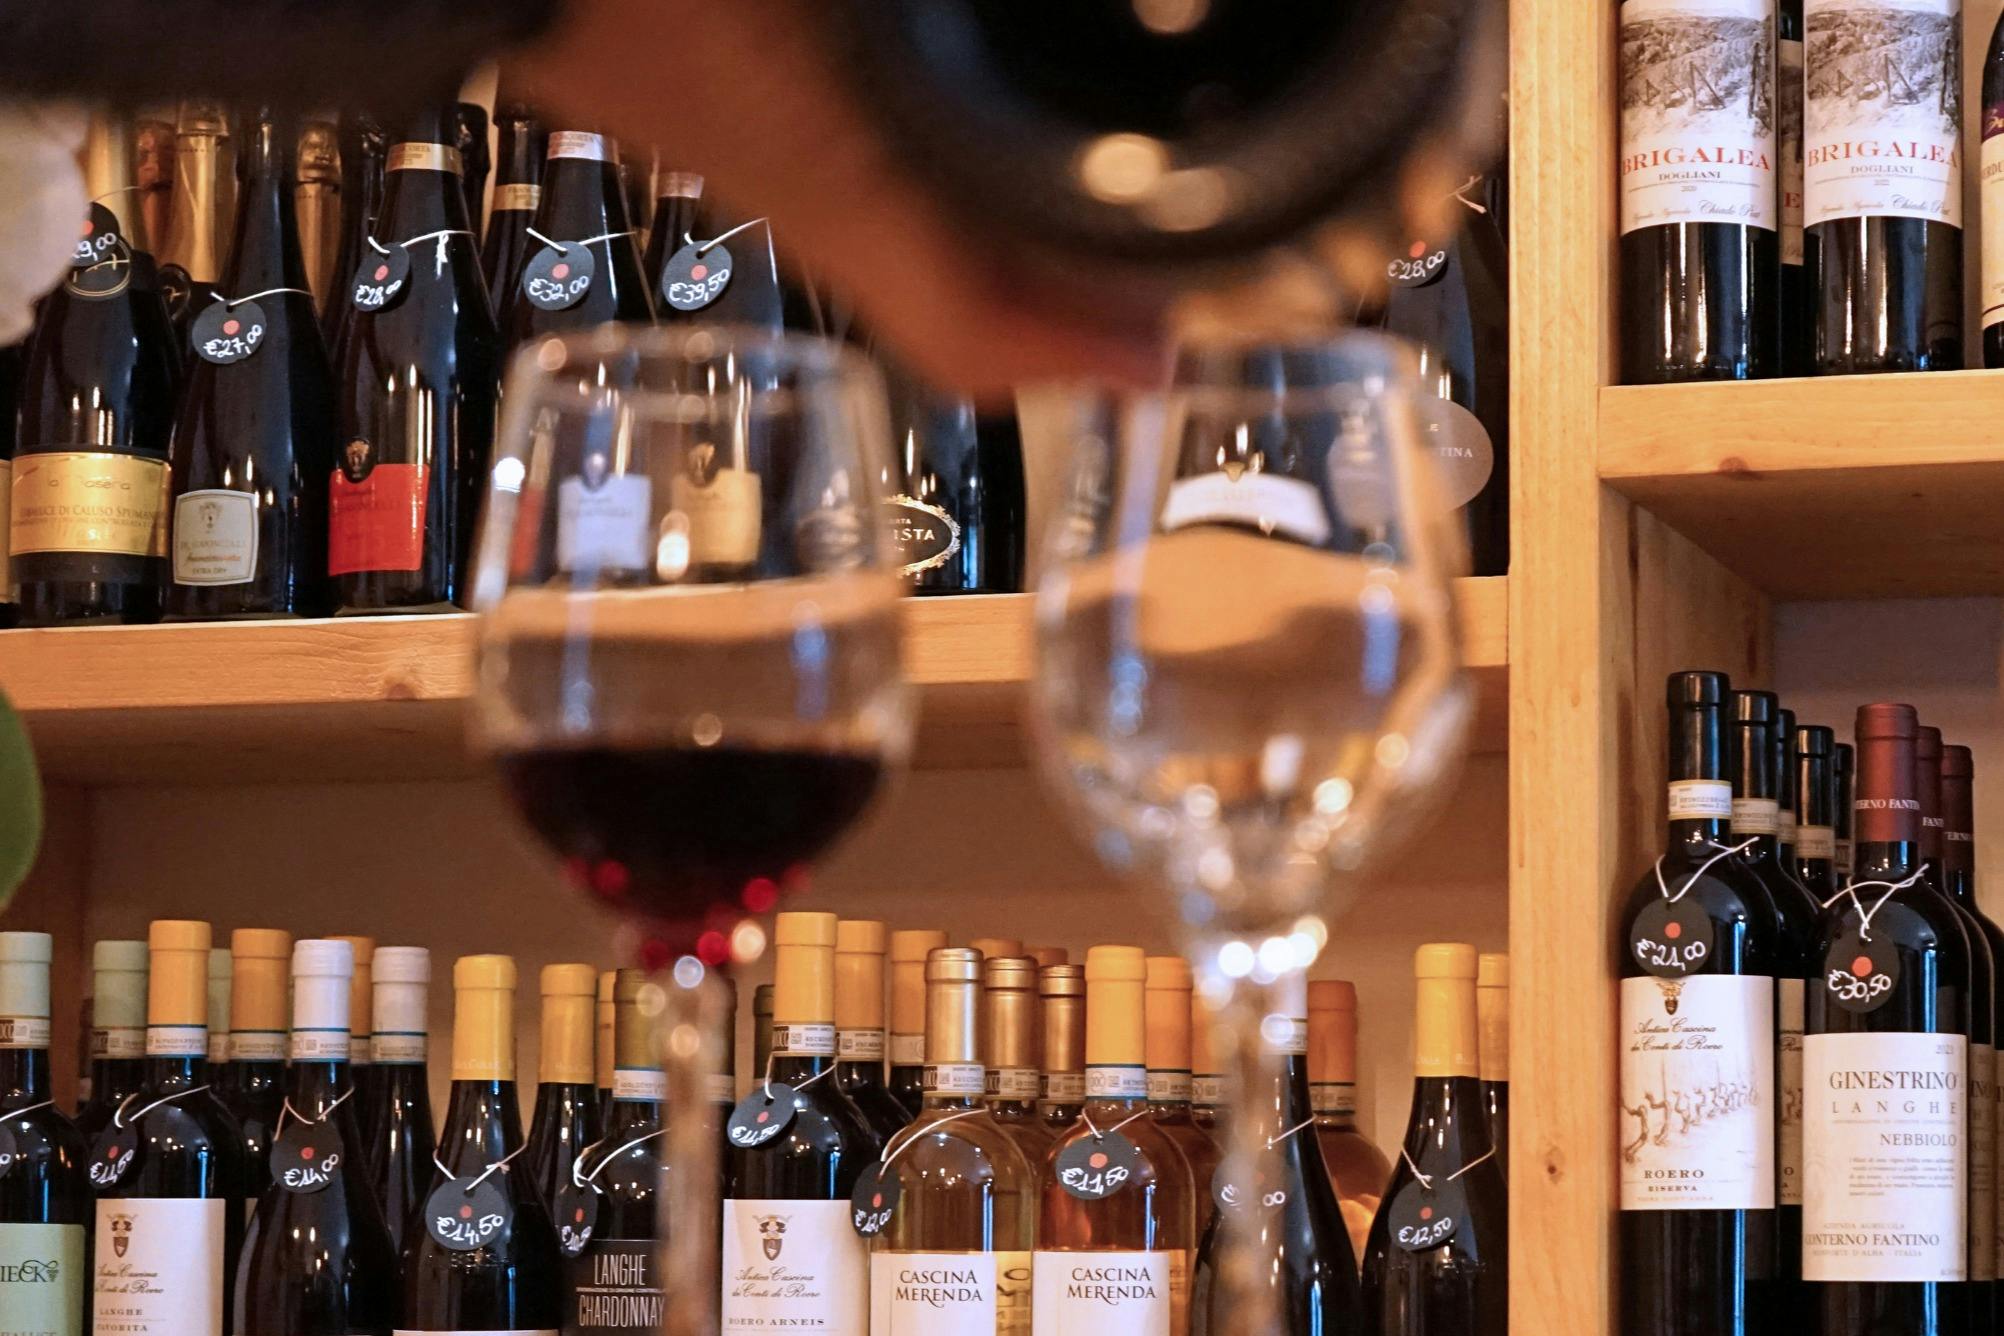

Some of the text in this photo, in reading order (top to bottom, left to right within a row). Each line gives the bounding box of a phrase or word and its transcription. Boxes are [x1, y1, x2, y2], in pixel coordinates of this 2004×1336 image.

[1623, 147, 1770, 175] BRIGALEA
[1807, 141, 1958, 168] BRIGALEA
[1659, 171, 1721, 181] DOGLIANI
[1850, 165, 1914, 174] DOGLIANI
[1387, 250, 1445, 279] €28,00
[355, 279, 402, 306] €28,00
[529, 275, 590, 302] €32,00
[668, 269, 730, 303] €39,50
[203, 324, 263, 358] €27,00
[1636, 938, 1706, 971] €21,00
[1828, 970, 1892, 1003] €30,50
[1829, 1071, 1957, 1090] GINESTRINO
[1832, 1101, 1957, 1114] LANGHE
[1880, 1133, 1957, 1146] NEBBIOLO
[284, 1154, 339, 1187] €14,00
[1062, 1166, 1129, 1195] €11,50
[1644, 1169, 1705, 1179] ROERO
[436, 1213, 504, 1245] €14,50
[1398, 1217, 1452, 1246] €12,50
[1873, 1233, 1940, 1246] FANTINO
[594, 1253, 647, 1286] LANGHE
[900, 1269, 978, 1284] CASCINA
[1072, 1267, 1152, 1282] CASCINA
[896, 1286, 983, 1309] MERENDA
[1067, 1285, 1157, 1306] MERENDA
[100, 1308, 143, 1316] LANGHE
[579, 1294, 665, 1328] CHARDONNAY
[728, 1317, 825, 1327] ROERO ARNEIS
